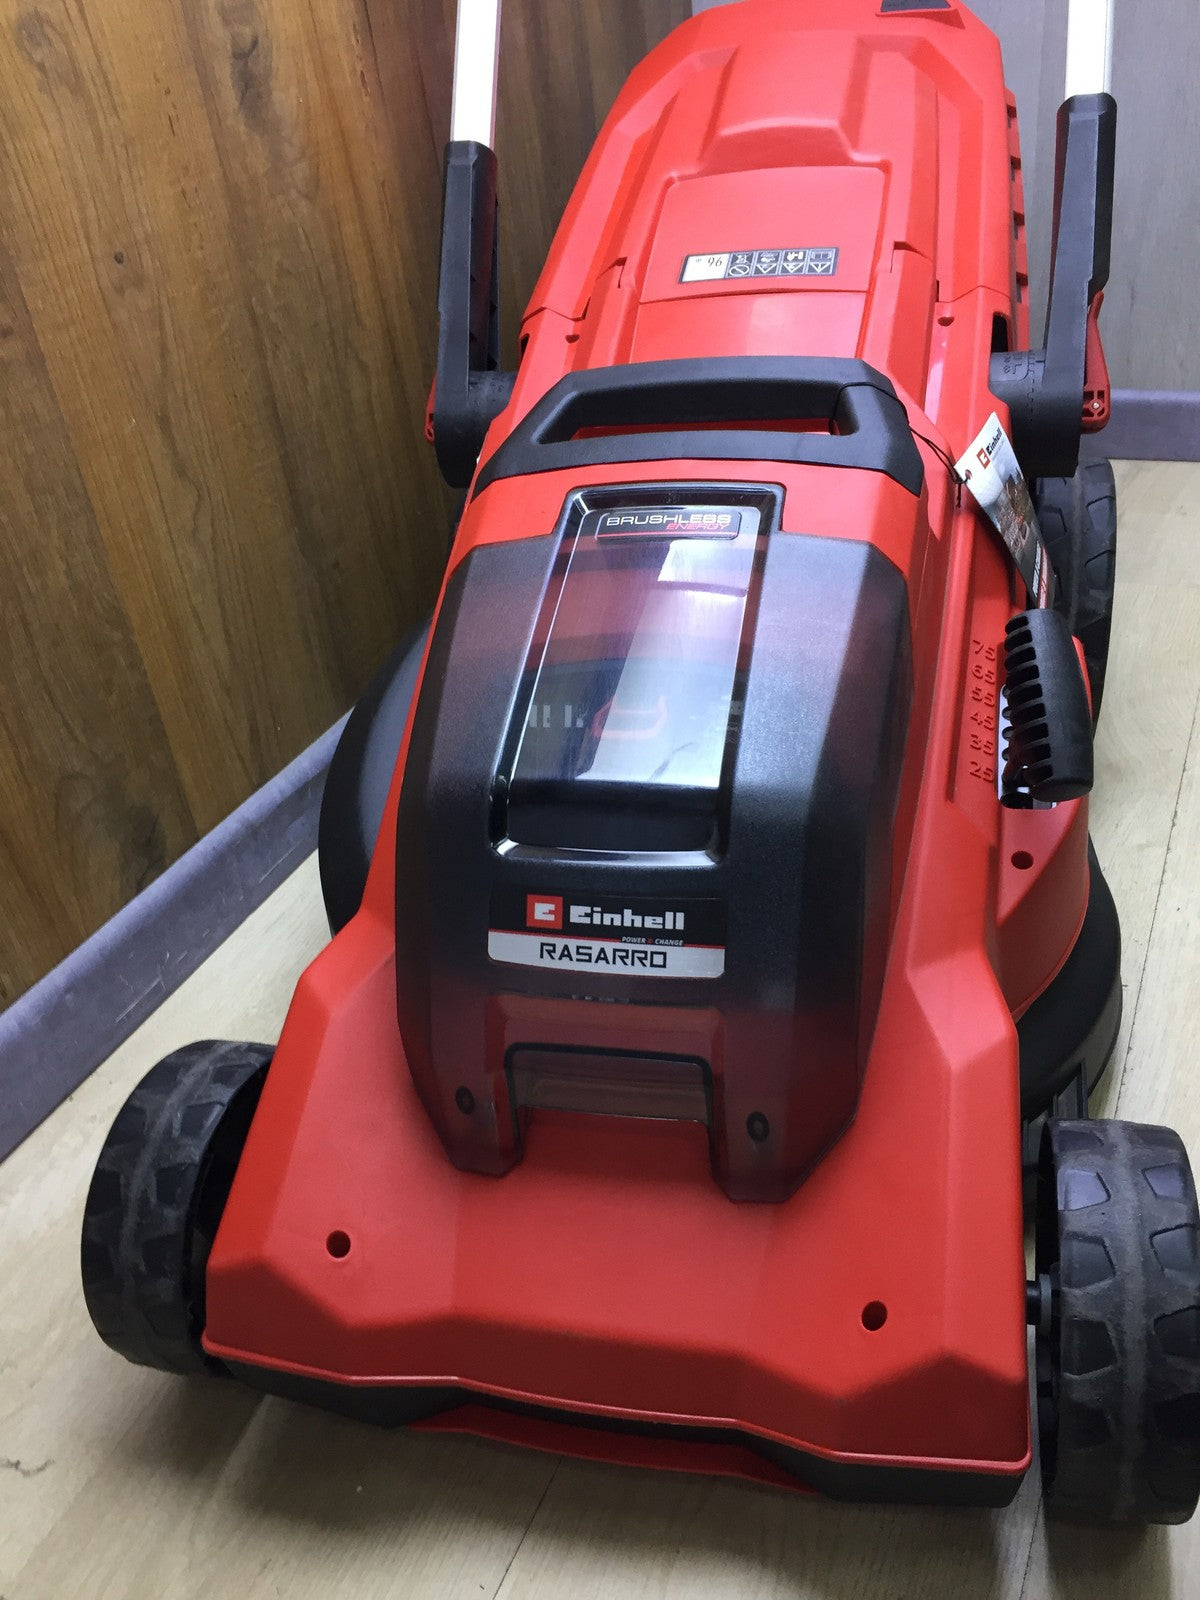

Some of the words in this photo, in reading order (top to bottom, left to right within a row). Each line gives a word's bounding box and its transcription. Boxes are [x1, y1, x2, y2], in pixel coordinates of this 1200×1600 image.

[707, 257, 723, 267] 96
[985, 427, 1003, 456] Einhell
[606, 514, 732, 526] BRUSHLESS
[972, 639, 996, 662] 75
[971, 664, 996, 685] 65
[971, 686, 996, 708] 55
[970, 712, 995, 732] 45
[969, 734, 994, 756] 35
[969, 761, 994, 784] 25
[569, 904, 685, 930] Einhell
[621, 936, 646, 944] POWER
[540, 942, 667, 968] RASARRO
